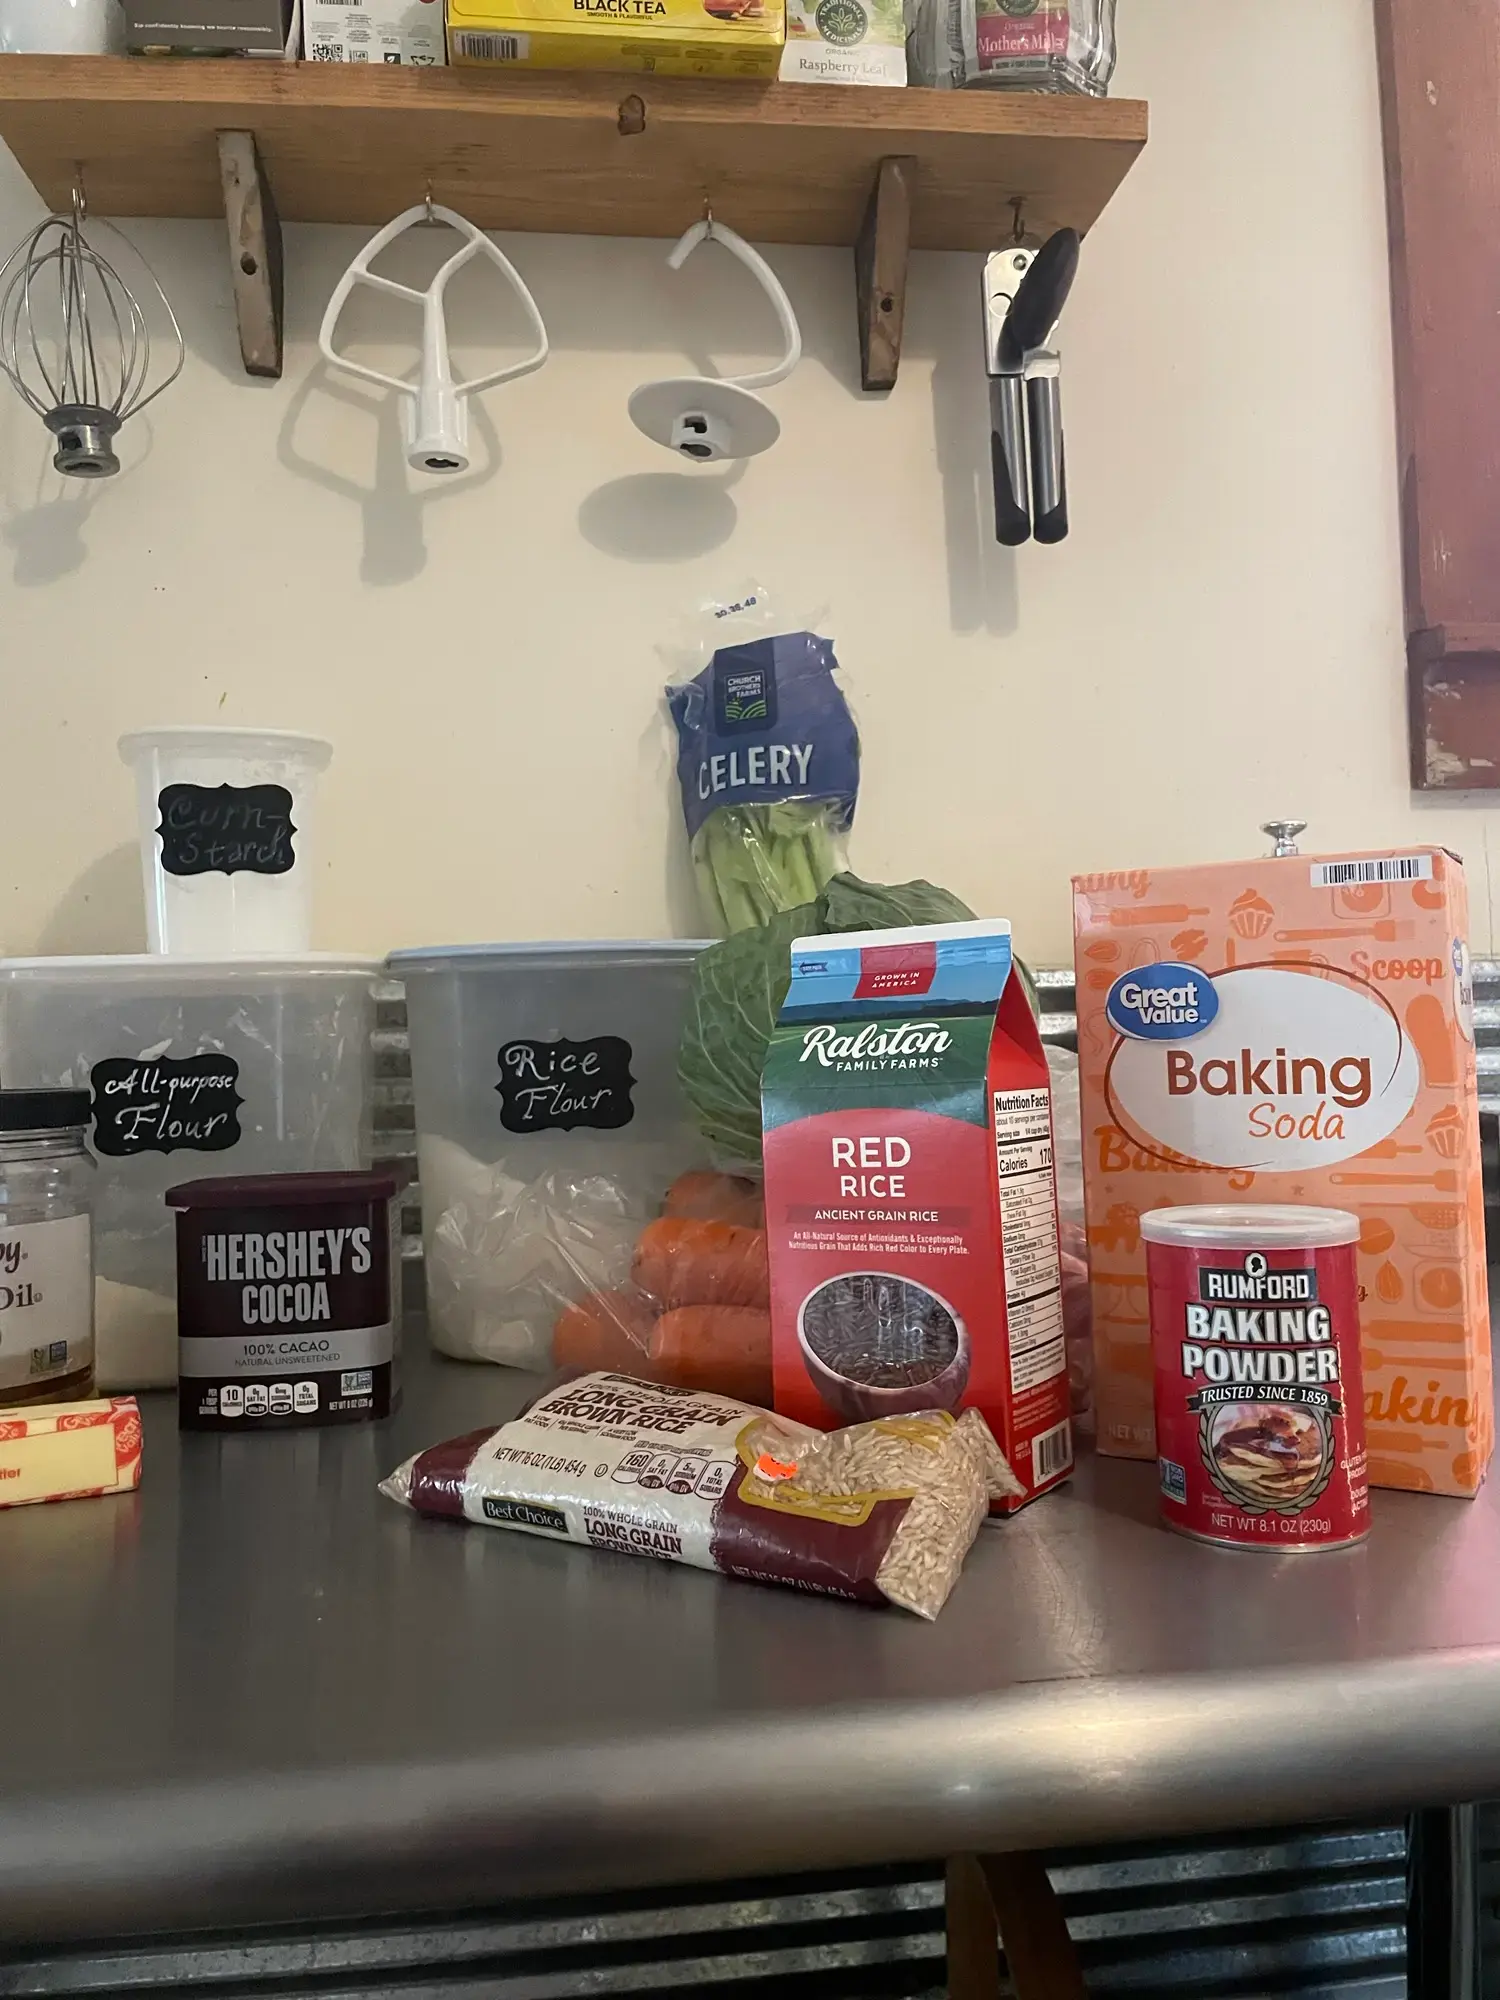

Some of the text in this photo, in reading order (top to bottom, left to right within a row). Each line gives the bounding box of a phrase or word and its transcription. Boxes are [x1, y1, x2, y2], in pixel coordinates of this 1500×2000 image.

[574, 0, 666, 15] BLACK TEA
[821, 25, 863, 43] MEDICINALS
[978, 35, 1029, 52] Mother's
[799, 58, 859, 74] Raspberry
[728, 675, 761, 686] CHURCH
[728, 683, 761, 693] BROTHERS
[736, 689, 761, 698] FARMS
[699, 744, 813, 800] CELERY
[874, 971, 920, 981] GROWN IN
[1349, 950, 1447, 986] Scoop
[872, 979, 917, 989] AMERICA
[1119, 981, 1199, 1009] Great
[1139, 1006, 1199, 1026] Value
[798, 1022, 953, 1067] Ralston
[505, 1044, 601, 1081] Rice
[836, 1057, 940, 1072] FAMILY FARMS
[104, 1067, 234, 1104] All-purpose
[1166, 1048, 1371, 1108] Baking
[515, 1082, 612, 1120] Flour
[995, 1094, 1048, 1111] Nutrition Facts
[114, 1102, 228, 1141] Flour
[1248, 1101, 1346, 1141] Soda
[832, 1136, 912, 1168] RED
[999, 1148, 1052, 1173] Calories 170
[841, 1175, 906, 1198] RICE
[815, 1209, 939, 1222] ANCIENT GRAIN RICE
[802, 1232, 835, 1241] All-Natural
[836, 1232, 859, 1242] Source
[868, 1233, 909, 1243] Antioxidants
[917, 1235, 963, 1246] Exceptionally
[819, 1241, 836, 1251] Grain
[852, 1243, 868, 1252] Adds
[869, 1243, 884, 1252] Rich
[885, 1244, 898, 1252] Red
[899, 1244, 918, 1253] Color
[928, 1245, 947, 1256] Every
[207, 1226, 372, 1281] HERSHEY'S
[1208, 1273, 1310, 1300] RUMFORD
[242, 1281, 331, 1325] COCOA
[1186, 1303, 1331, 1344] BAKING
[244, 1339, 330, 1356] 100% CACAO
[235, 1353, 341, 1367] NATURAL UNSWEETENED
[1182, 1343, 1339, 1383] POWDER
[226, 1389, 239, 1401] 10
[1201, 1386, 1329, 1406] TRUSTED SINCE 1859
[1364, 1376, 1477, 1428] akin
[539, 1400, 696, 1434] BROWN RICE
[560, 1389, 741, 1426] LONG GRAIN
[686, 1401, 746, 1415] GRAIN
[492, 1447, 512, 1460] NET
[508, 1449, 525, 1463] WT
[520, 1451, 534, 1465] 16
[530, 1453, 546, 1467] OZ
[626, 1454, 649, 1467] 160
[658, 1468, 668, 1476] FAT
[706, 1477, 722, 1485] TOTAL
[486, 1501, 565, 1529] Best Choice
[583, 1505, 678, 1534] 100% WHOLE GRAIN
[1211, 1513, 1332, 1535] NET WT 8.1 OZ (230g)
[584, 1518, 683, 1555] LONG GRAIN
